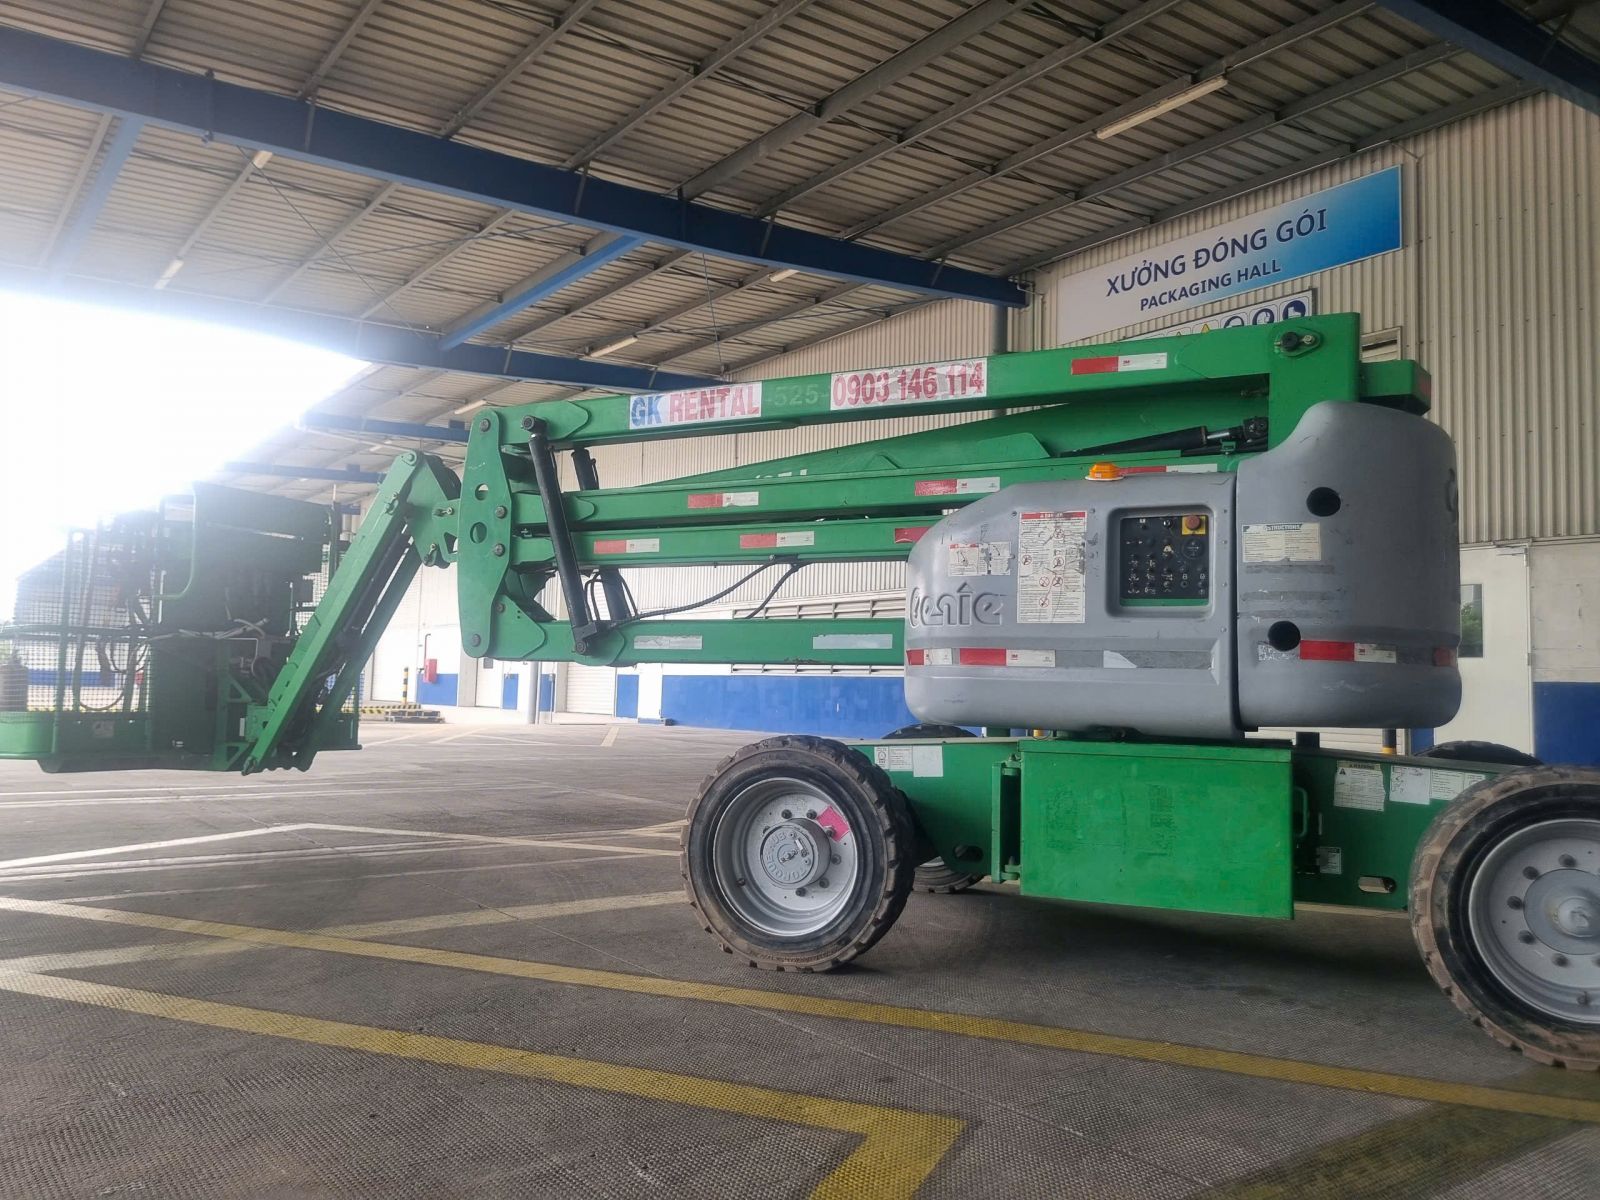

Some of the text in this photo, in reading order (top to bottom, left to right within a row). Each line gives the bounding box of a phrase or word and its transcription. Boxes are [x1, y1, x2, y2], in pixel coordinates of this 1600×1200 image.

[1106, 208, 1327, 297] XƯỞNG ĐÓNG GÓI
[1140, 260, 1281, 311] PACKAGING HALL
[631, 385, 760, 427] GK RENTAL
[833, 362, 985, 407] 0903 146 114
